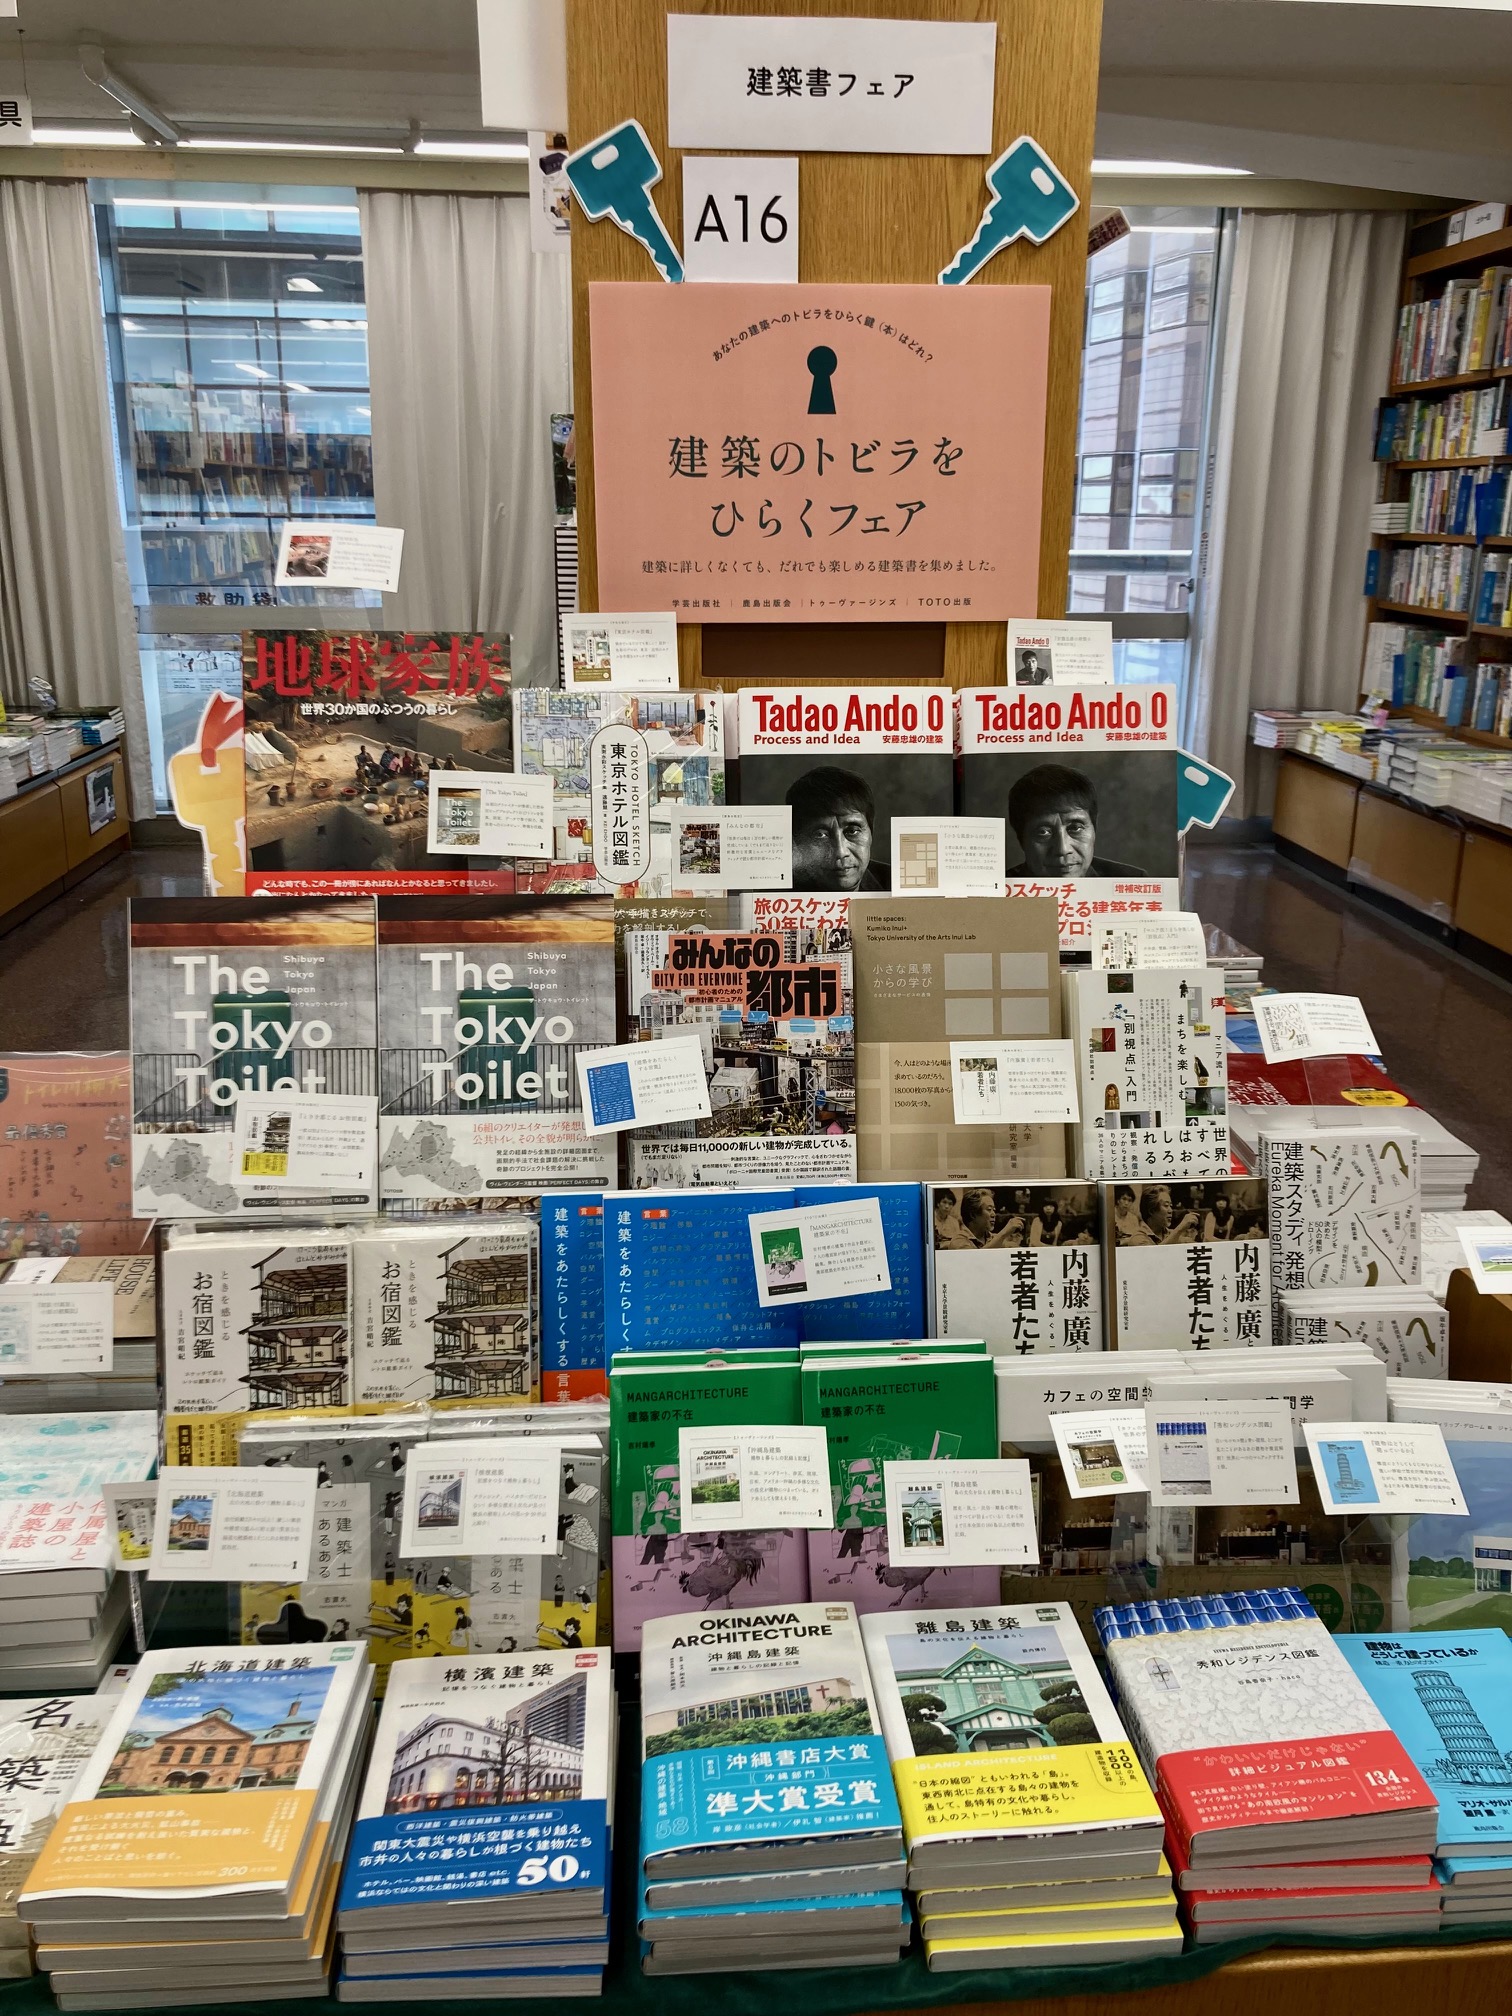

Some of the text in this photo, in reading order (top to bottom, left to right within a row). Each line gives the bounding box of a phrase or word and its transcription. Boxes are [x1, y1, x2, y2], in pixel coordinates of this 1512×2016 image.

[746, 66, 916, 98] 建築書フェア
[694, 194, 789, 243] A16
[668, 436, 965, 479] 建築のトビラを
[710, 499, 927, 538] ひらくフェア
[641, 558, 998, 575] 建築に詳しくなくても、だれでも楽しめる建築書を集めました。
[672, 599, 721, 608] 学芸出版社
[742, 598, 792, 608] 鹿島出版会
[809, 598, 897, 608] トゥーヴァージンズ
[918, 597, 972, 608] TOTO出版
[249, 634, 507, 699] 地球家族
[300, 702, 458, 716] 世界30か国のふつうの暮らし
[753, 694, 919, 732] Tadao Ando
[976, 691, 1141, 731] Tadao Ando
[754, 734, 944, 746] Process and Idea 安藤忠雄の建築
[977, 732, 1168, 745] Process and Idea 安藤忠雄の建築
[445, 798, 463, 806] The
[610, 742, 629, 866] 東京ホテル図鑑
[630, 744, 641, 866] TOKYO HOTEL SKETCH
[445, 808, 474, 818] Tokyo
[445, 818, 473, 827] Toilet
[1115, 885, 1162, 894] 増補改訂版
[866, 915, 907, 924] little spaces:
[867, 935, 885, 943] Tokyo
[886, 934, 916, 943] University
[284, 955, 325, 964] Shibuya
[527, 952, 567, 962] Shibuya
[672, 937, 780, 971] みんなの
[173, 955, 270, 995] The
[284, 971, 315, 979] Tokyo
[421, 952, 514, 992] The
[527, 967, 557, 976] Tokyo
[872, 963, 933, 975] 小さな風景
[527, 981, 558, 991] Japan
[654, 973, 743, 987] CITY FOR EVERYONE
[873, 977, 933, 989] からの学び
[284, 986, 316, 994] Japan
[746, 966, 837, 1018] 都市
[688, 996, 743, 1004] 都市計画マニュアル
[174, 1009, 333, 1060] Tokyo
[422, 1005, 574, 1054] Tokyo
[1176, 1013, 1189, 1101] まちを楽しむ
[1214, 1035, 1224, 1077] マニア流！
[422, 1059, 569, 1102] Toilet
[893, 1073, 945, 1081] 求めているのだろう。
[893, 1100, 931, 1108] 150の気づき。
[641, 1139, 852, 1154] 世界では毎日11,000の新しい建物が完成している。
[1271, 1142, 1285, 1281] Eureka Moment for
[1284, 1141, 1305, 1290] 建築スタディ 発想
[113, 1258, 153, 1296] HOUSE
[381, 1260, 403, 1347] お宿図鑑
[407, 1259, 418, 1330] ときを感じる
[1011, 1251, 1040, 1355] 若者たち
[192, 1271, 215, 1359] お宿図鑑
[220, 1270, 231, 1341] ときを感じる
[626, 1386, 749, 1404] MANGARCHITECTURE
[819, 1381, 940, 1399] MANGARCHITECTURE
[627, 1408, 694, 1424] 建築家の不在
[820, 1404, 886, 1419] 建築家の不在
[322, 1500, 348, 1508] マンガ
[8, 1501, 55, 1550] 建築誌
[45, 1501, 84, 1546] 小屋の
[318, 1517, 332, 1579] あるある
[336, 1517, 353, 1578] 建築士
[700, 1612, 801, 1631] OKINAWA
[915, 1617, 1022, 1635] 離島建築
[671, 1624, 833, 1649] ARCHITECTURE
[919, 1633, 1025, 1643] 島の文化を伝える建物と暮らし
[1364, 1641, 1403, 1651] 建物は
[708, 1646, 800, 1663] 沖縄島建築
[1196, 1648, 1320, 1669] 秀和レジデンス図鑑
[1370, 1648, 1479, 1660] どうして建っているか
[185, 1656, 313, 1674] 北海道建築
[444, 1663, 555, 1683] 横濱建築
[710, 1660, 800, 1672] 建物と暮らしの記録と記憶
[442, 1680, 554, 1693] 記憶をつなぐ建物と暮らし
[18, 1698, 75, 1730] 名
[726, 1743, 872, 1771] 沖縄書店大賞
[915, 1753, 1058, 1771] ISLAND ARCHITECTURE
[764, 1769, 816, 1782] 沖縄部門
[1228, 1757, 1351, 1777] 詳細ビジュアル図鑑
[980, 1770, 1070, 1784] ともいわれる「島」。
[1365, 1769, 1400, 1787] 134
[705, 1780, 881, 1818] 準大賞受賞
[921, 1780, 1080, 1800] 東西南北に点在する島々の建物を
[924, 1793, 1076, 1812] 通して、島特有の文化や暮らし、
[926, 1805, 1060, 1824] 住人のストーリーに触れる。
[372, 1823, 582, 1852] 関東大震災や横浜空襲を乗り越え
[655, 1817, 689, 1840] 58
[359, 1837, 592, 1868] 市井の人々の暮らしが根づく建物たち
[217, 1866, 249, 1877] 300
[516, 1854, 579, 1886] 50
[357, 1877, 510, 1899] 横浜ならではの文化と関わりの深い建築
